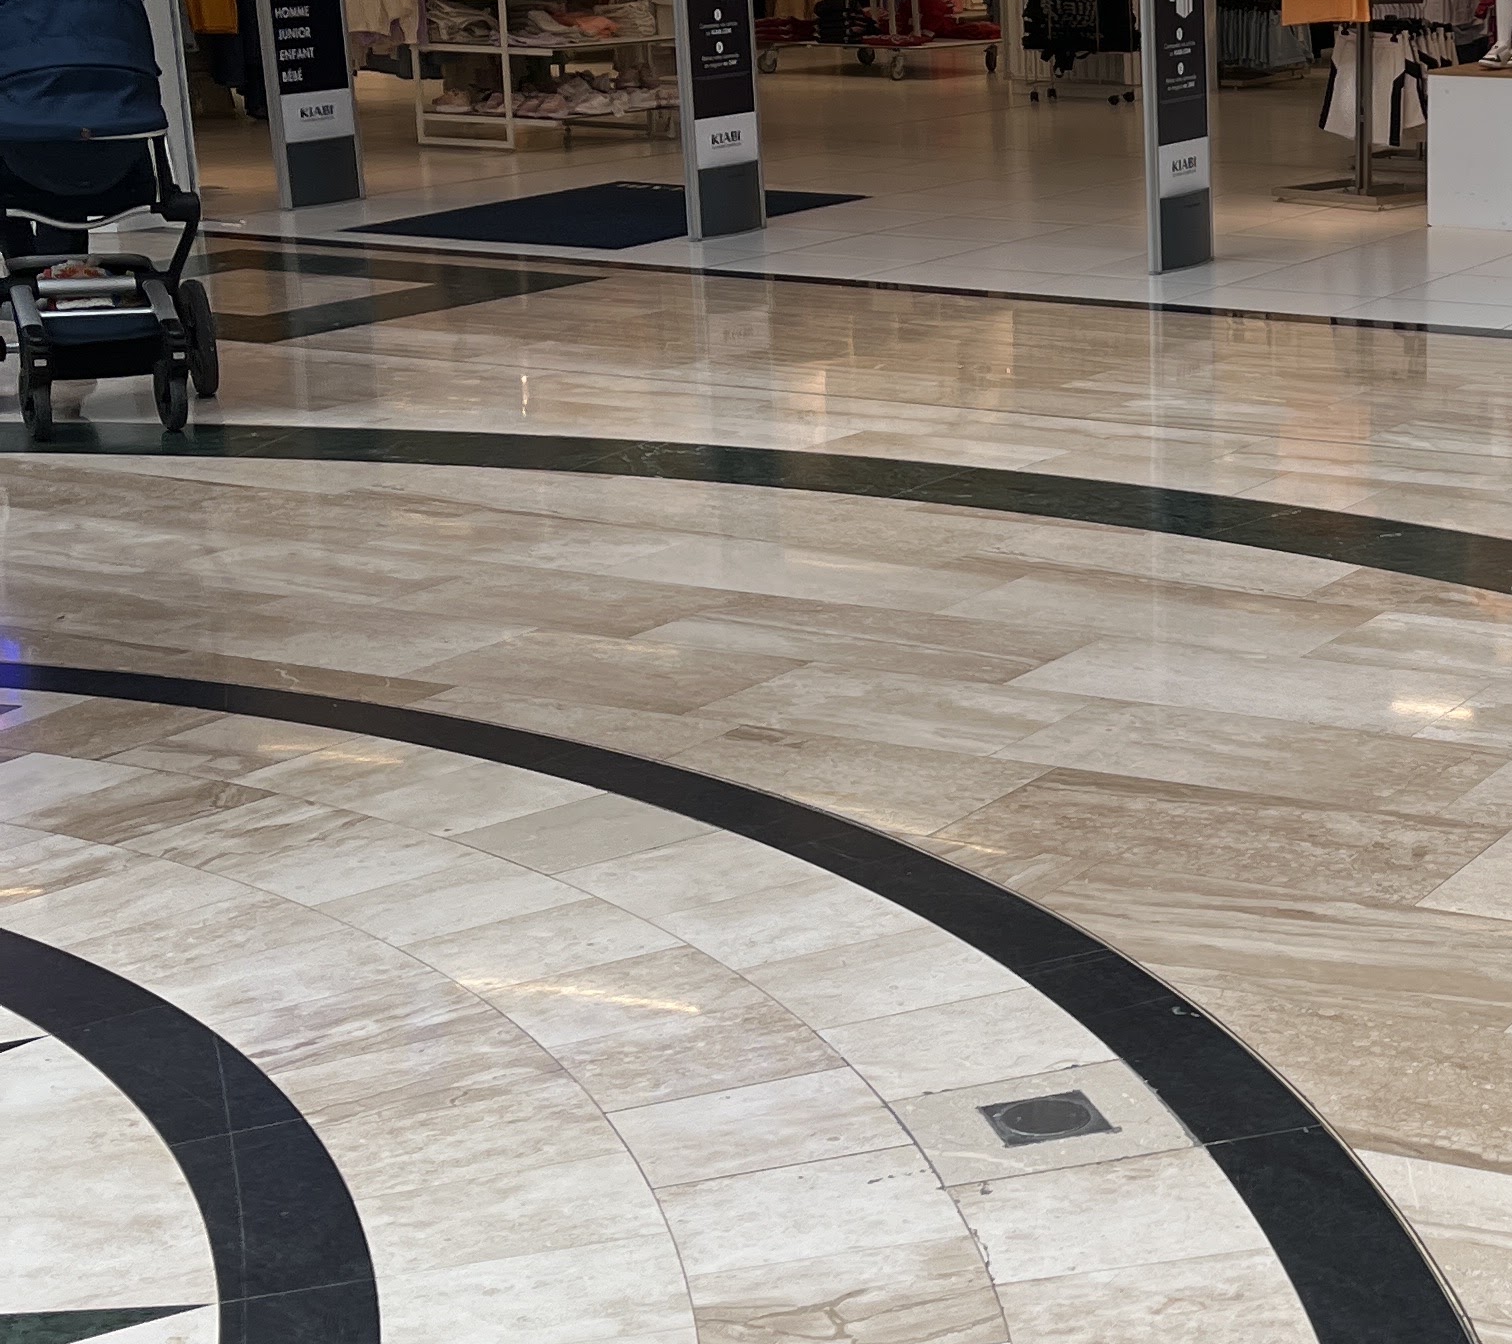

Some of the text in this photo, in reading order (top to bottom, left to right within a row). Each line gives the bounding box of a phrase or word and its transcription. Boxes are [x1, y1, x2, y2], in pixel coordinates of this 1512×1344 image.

[275, 5, 310, 19] HOMME
[278, 26, 312, 41] JUNIOR
[279, 47, 315, 61] ENFANT
[282, 67, 303, 83] BÉBÉ
[300, 104, 334, 118] KIABI
[711, 130, 742, 146] KIABI
[1171, 156, 1197, 173] KIABI
